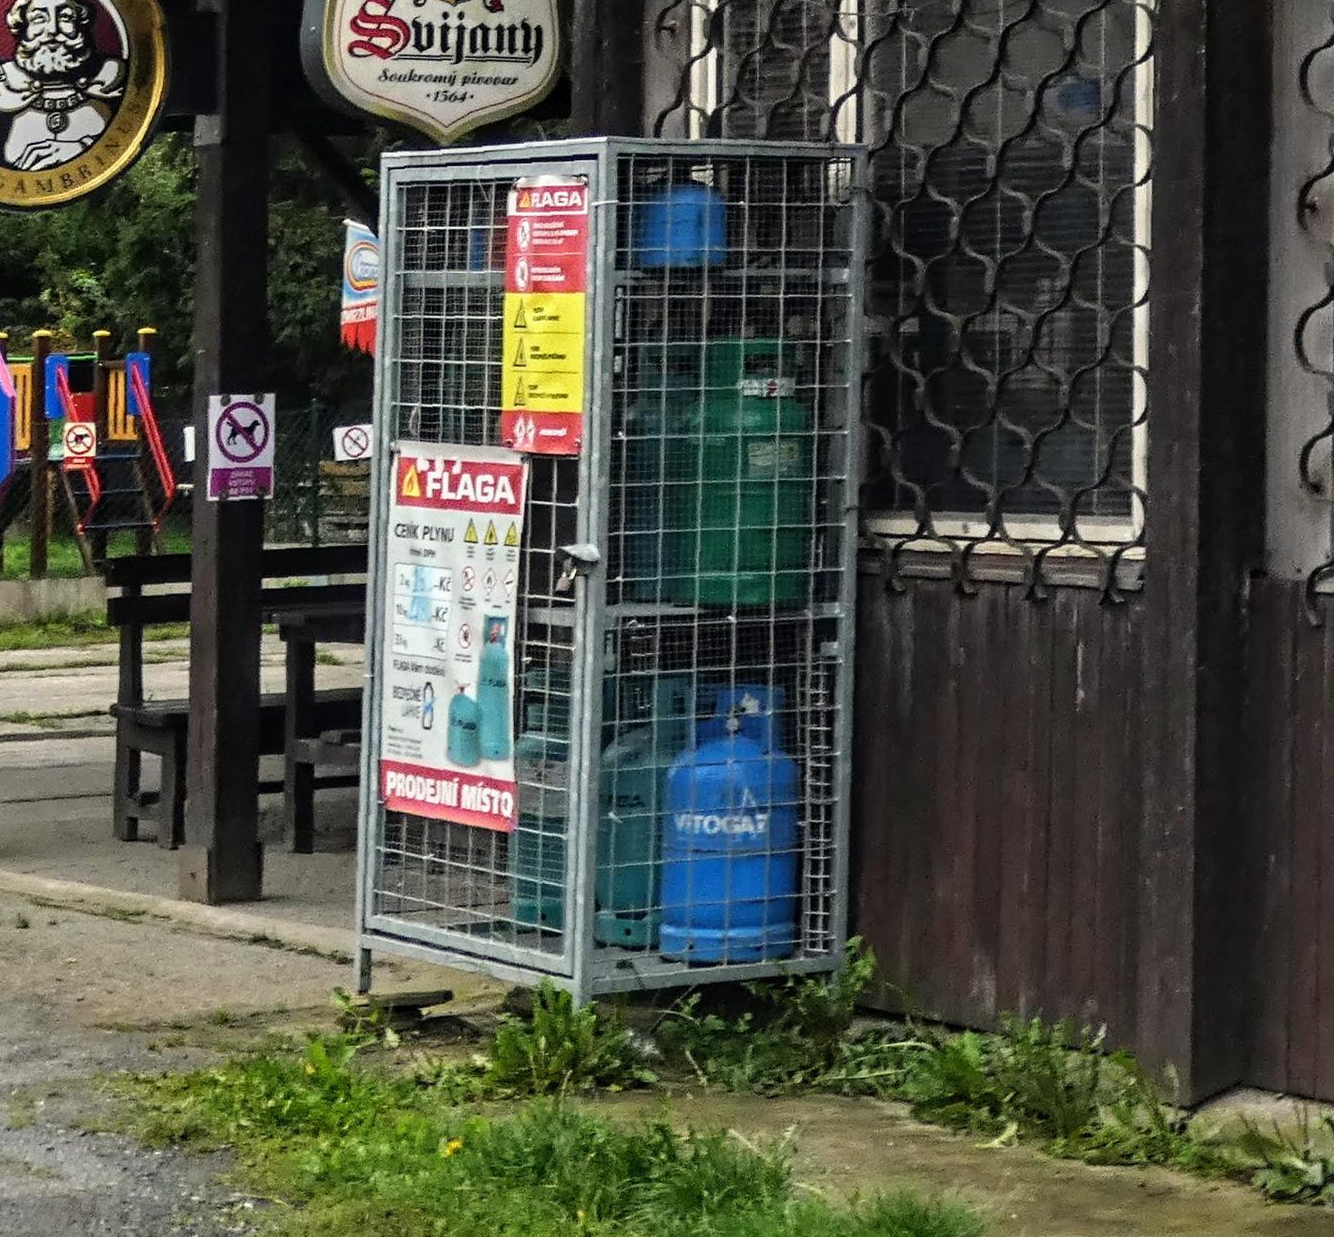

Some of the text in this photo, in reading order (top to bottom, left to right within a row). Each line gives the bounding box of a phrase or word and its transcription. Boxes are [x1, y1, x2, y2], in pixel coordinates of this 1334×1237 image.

[461, 71, 519, 86] pivovar
[531, 191, 582, 208] FLAGA
[426, 471, 515, 504] FLAGA
[422, 525, 455, 543] PLYNU
[386, 771, 514, 818] PRODEJNÍ MÍSTO
